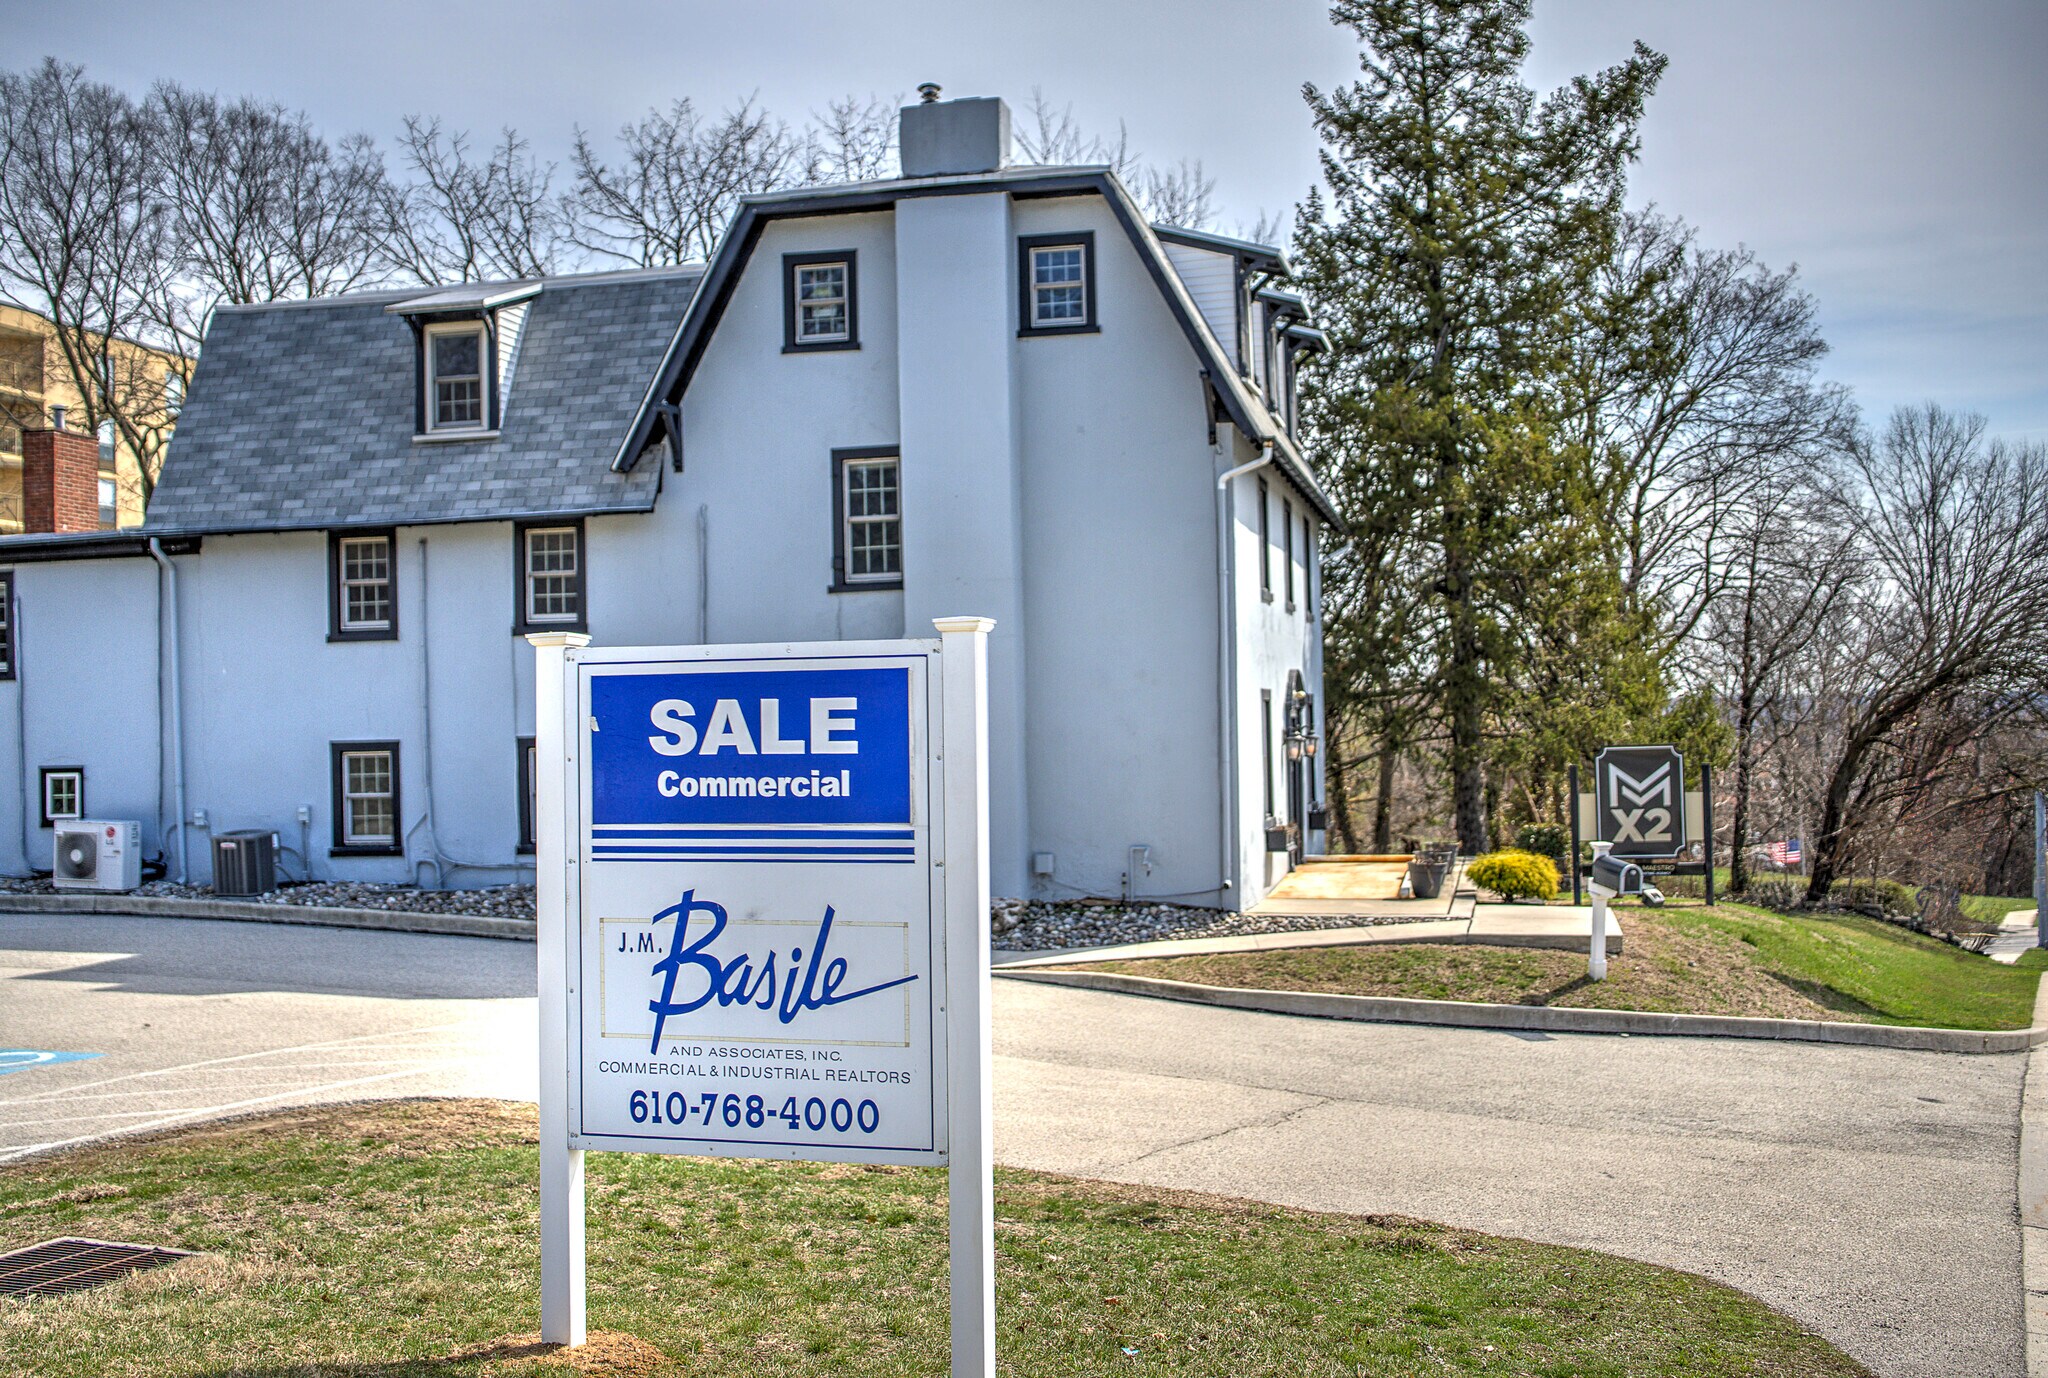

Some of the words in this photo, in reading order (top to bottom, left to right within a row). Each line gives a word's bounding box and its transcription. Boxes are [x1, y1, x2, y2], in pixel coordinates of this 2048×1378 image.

[649, 697, 859, 757] SALE
[657, 769, 850, 798] Commercial
[1610, 807, 1672, 843] X2
[618, 932, 663, 954] J.M.
[649, 888, 919, 1055] Basile
[598, 1060, 706, 1077] COMMERCIAL
[709, 1065, 719, 1077] &
[723, 1065, 820, 1081] INDUSTRIAL
[825, 1069, 911, 1084] REALTORS
[670, 1046, 703, 1057] AND
[708, 1047, 807, 1062] ASSOCIATES,
[812, 1050, 843, 1062] INC.
[629, 1089, 880, 1134] 610-768-4000
